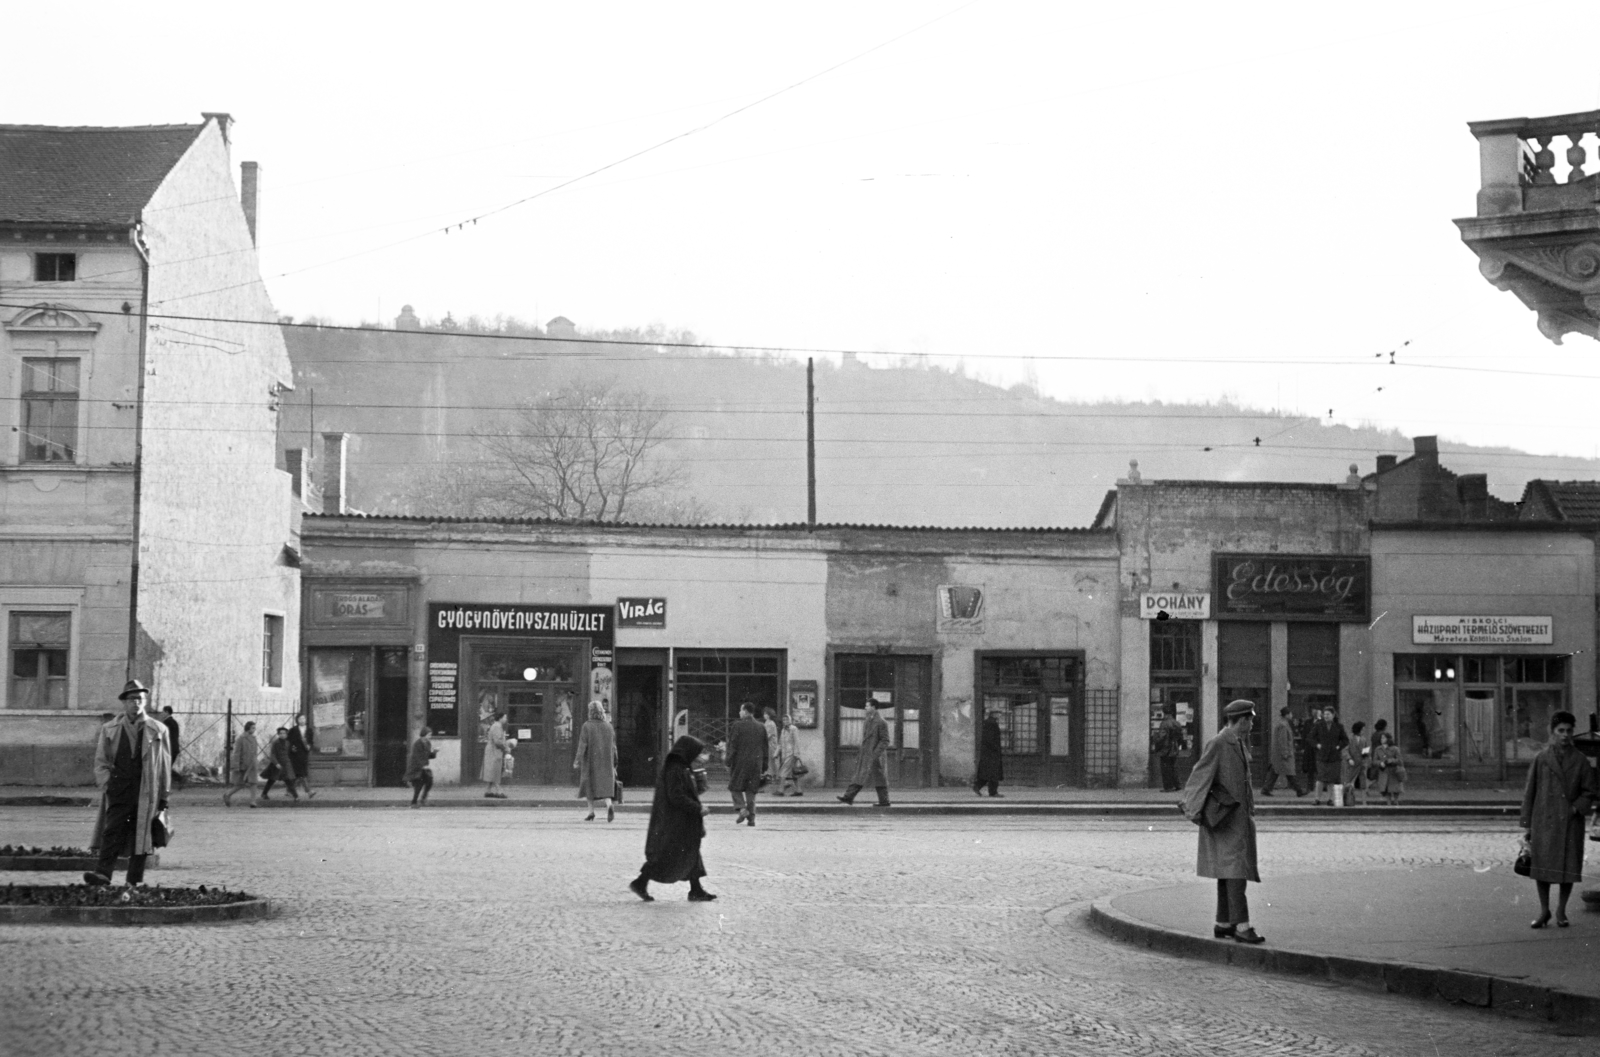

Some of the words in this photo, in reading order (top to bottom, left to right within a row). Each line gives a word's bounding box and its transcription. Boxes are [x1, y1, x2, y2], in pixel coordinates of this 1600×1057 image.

[619, 598, 664, 620] VIRÁG
[1146, 593, 1205, 609] DOHÁNY
[437, 609, 606, 631] GYÓGYNÖVÉNYSZAKÜZLET
[1498, 622, 1549, 635] SZÖVETKEZET
